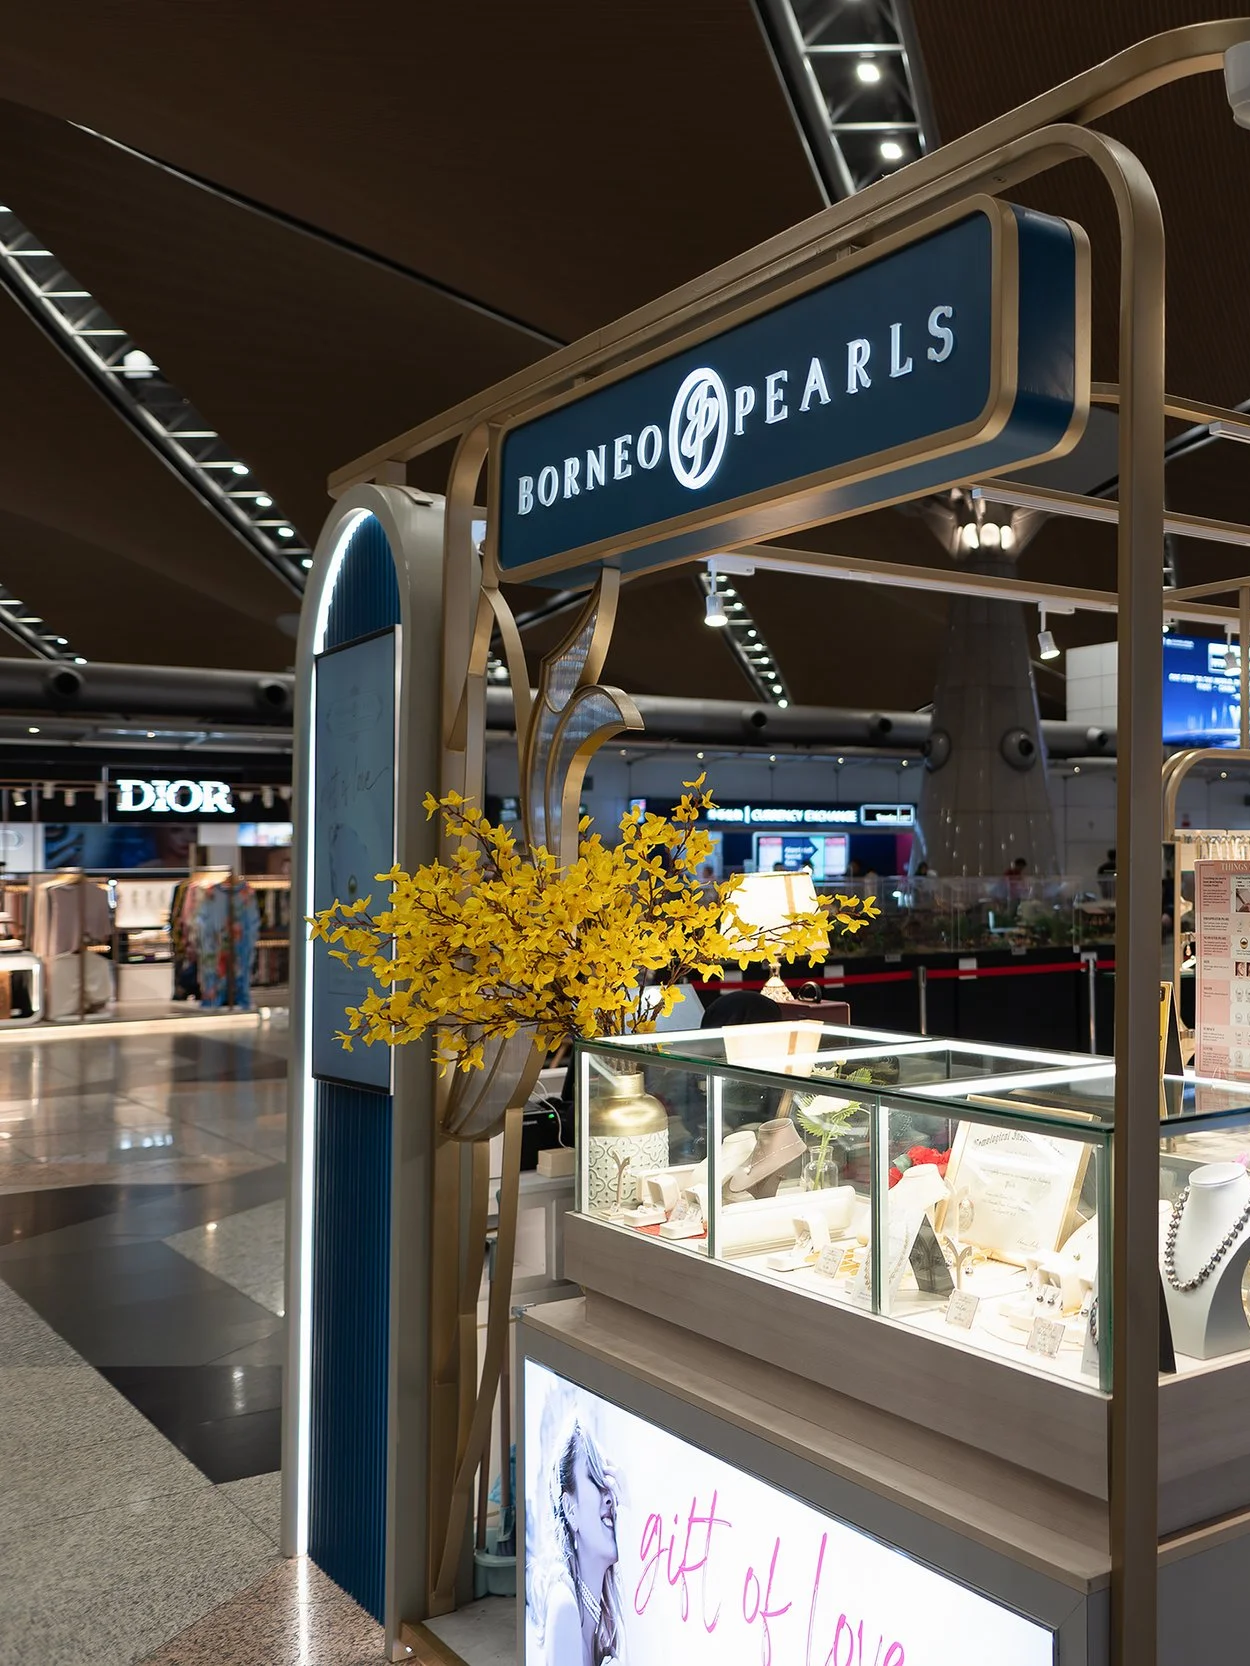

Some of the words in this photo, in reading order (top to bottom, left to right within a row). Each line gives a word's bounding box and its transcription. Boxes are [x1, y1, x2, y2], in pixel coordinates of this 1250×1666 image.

[516, 423, 662, 517] BORNEO
[733, 304, 956, 437] PEARLS
[116, 779, 236, 814] DIOR
[1221, 862, 1248, 871] THINGS
[633, 1489, 733, 1633] gift
[742, 1537, 793, 1666] of
